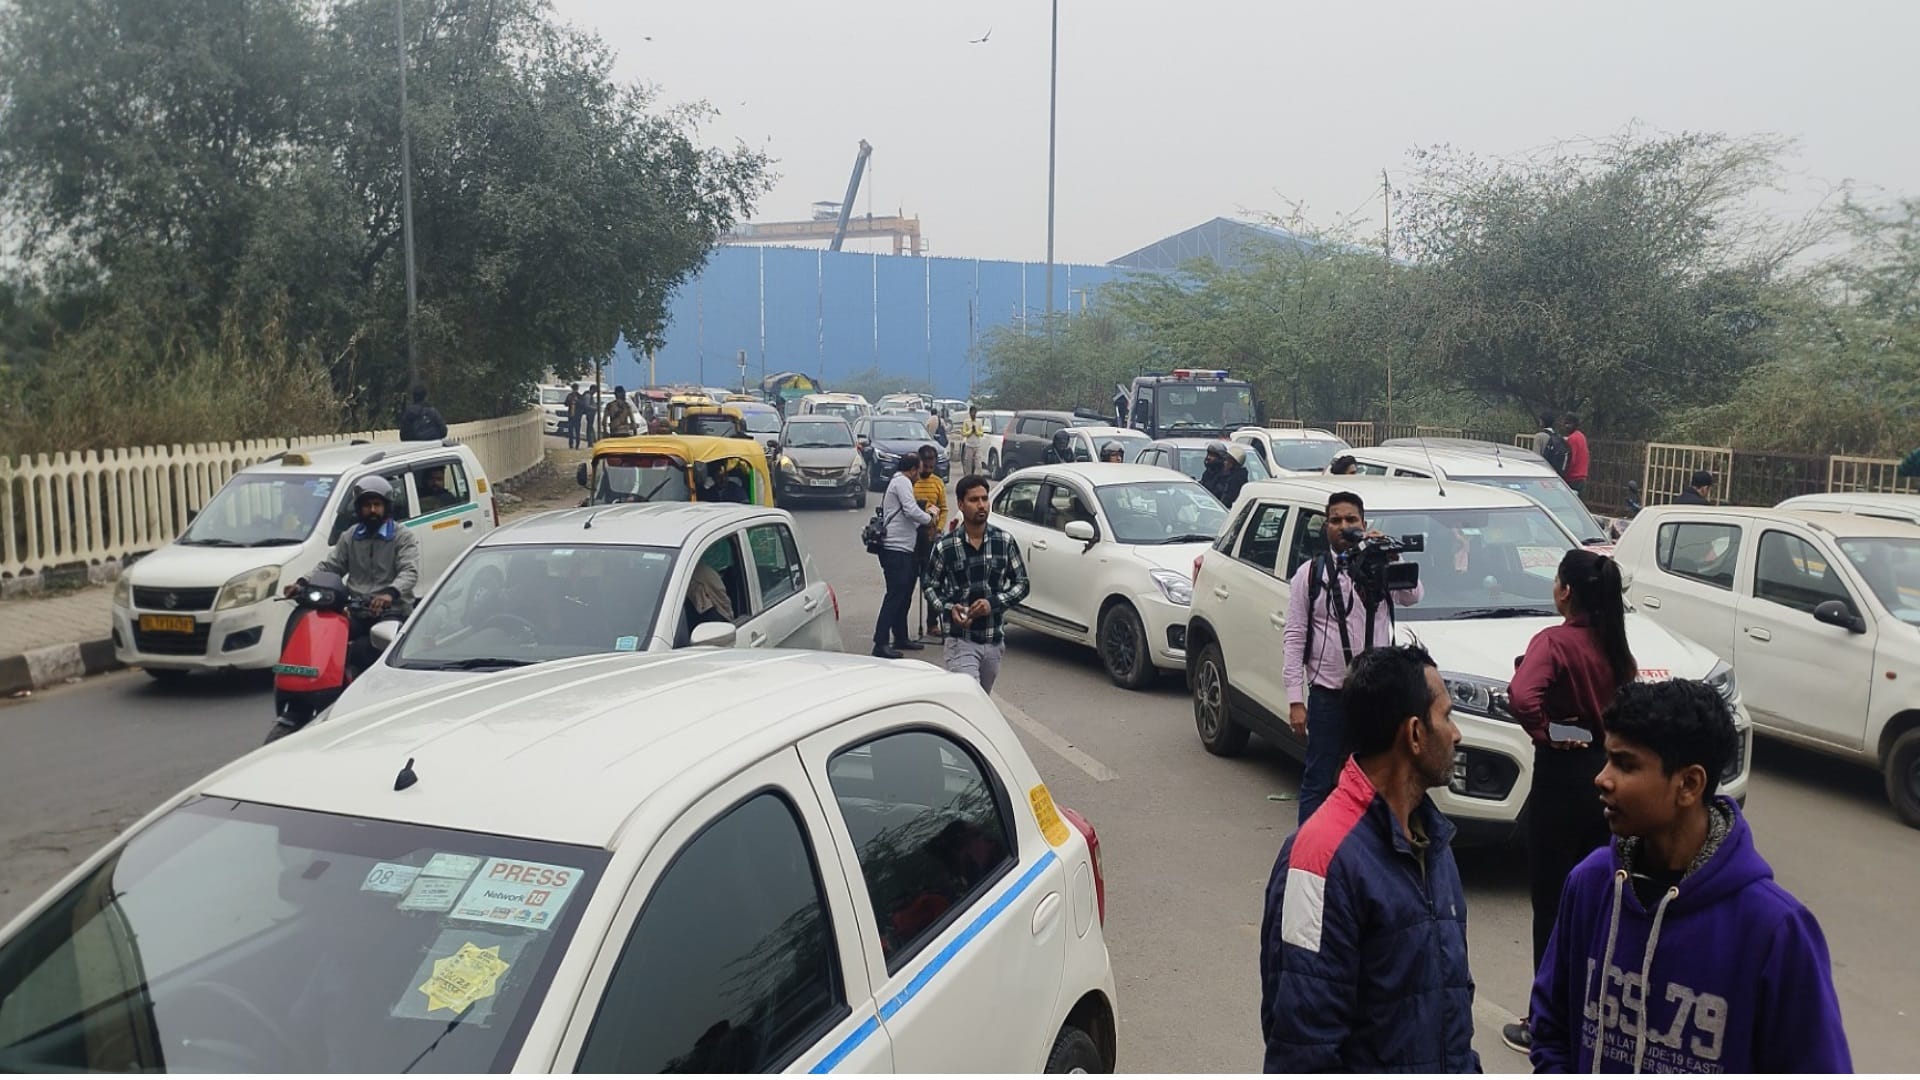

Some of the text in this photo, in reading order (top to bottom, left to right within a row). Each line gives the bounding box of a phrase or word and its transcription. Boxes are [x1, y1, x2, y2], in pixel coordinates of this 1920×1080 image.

[488, 862, 571, 887] PRESS
[483, 889, 544, 904] Network 18
